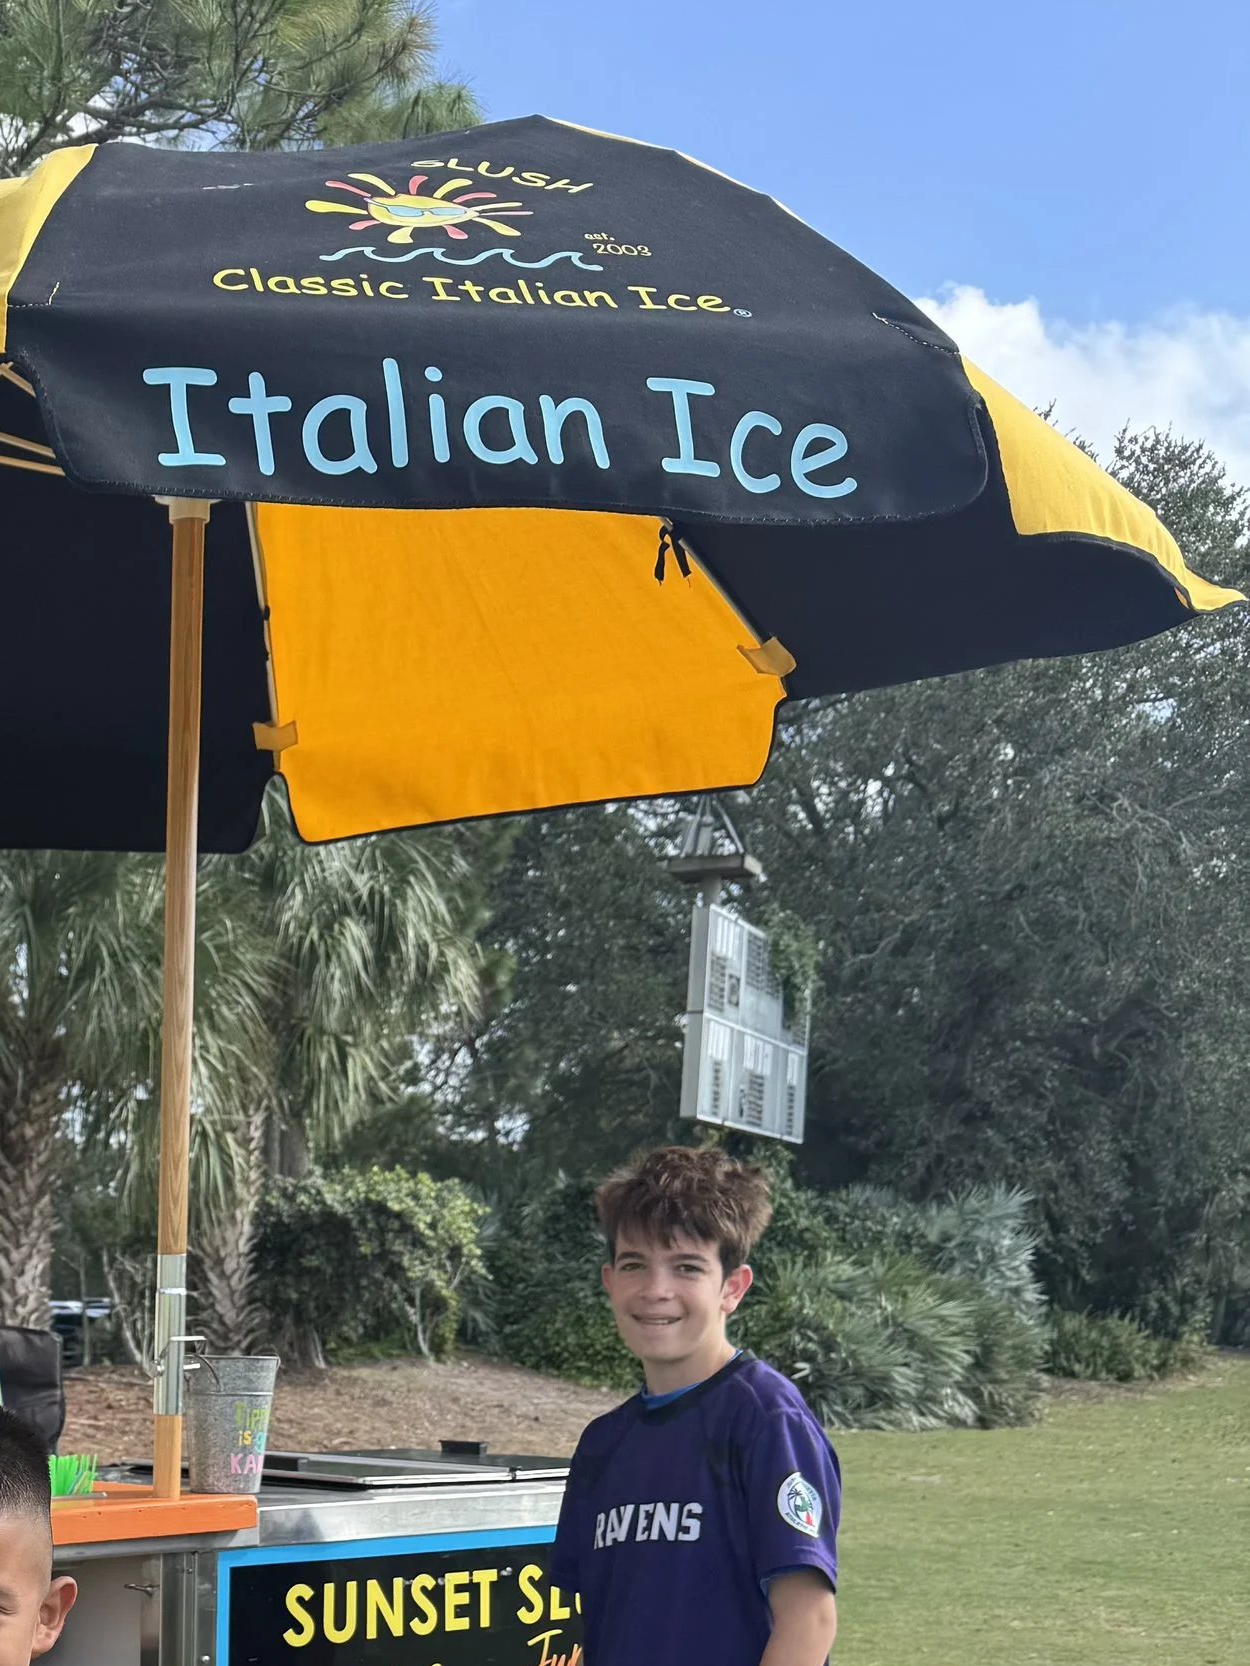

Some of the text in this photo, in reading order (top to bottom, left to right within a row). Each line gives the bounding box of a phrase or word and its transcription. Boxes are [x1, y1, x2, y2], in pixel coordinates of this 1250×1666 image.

[410, 158, 594, 194] SLUSH
[592, 243, 652, 257] 2003
[211, 267, 411, 301] Classic
[430, 274, 619, 311] Italian
[142, 357, 859, 500] Italian Ice
[593, 1502, 703, 1550] RAVENS
[283, 1569, 497, 1648] SUNSET
